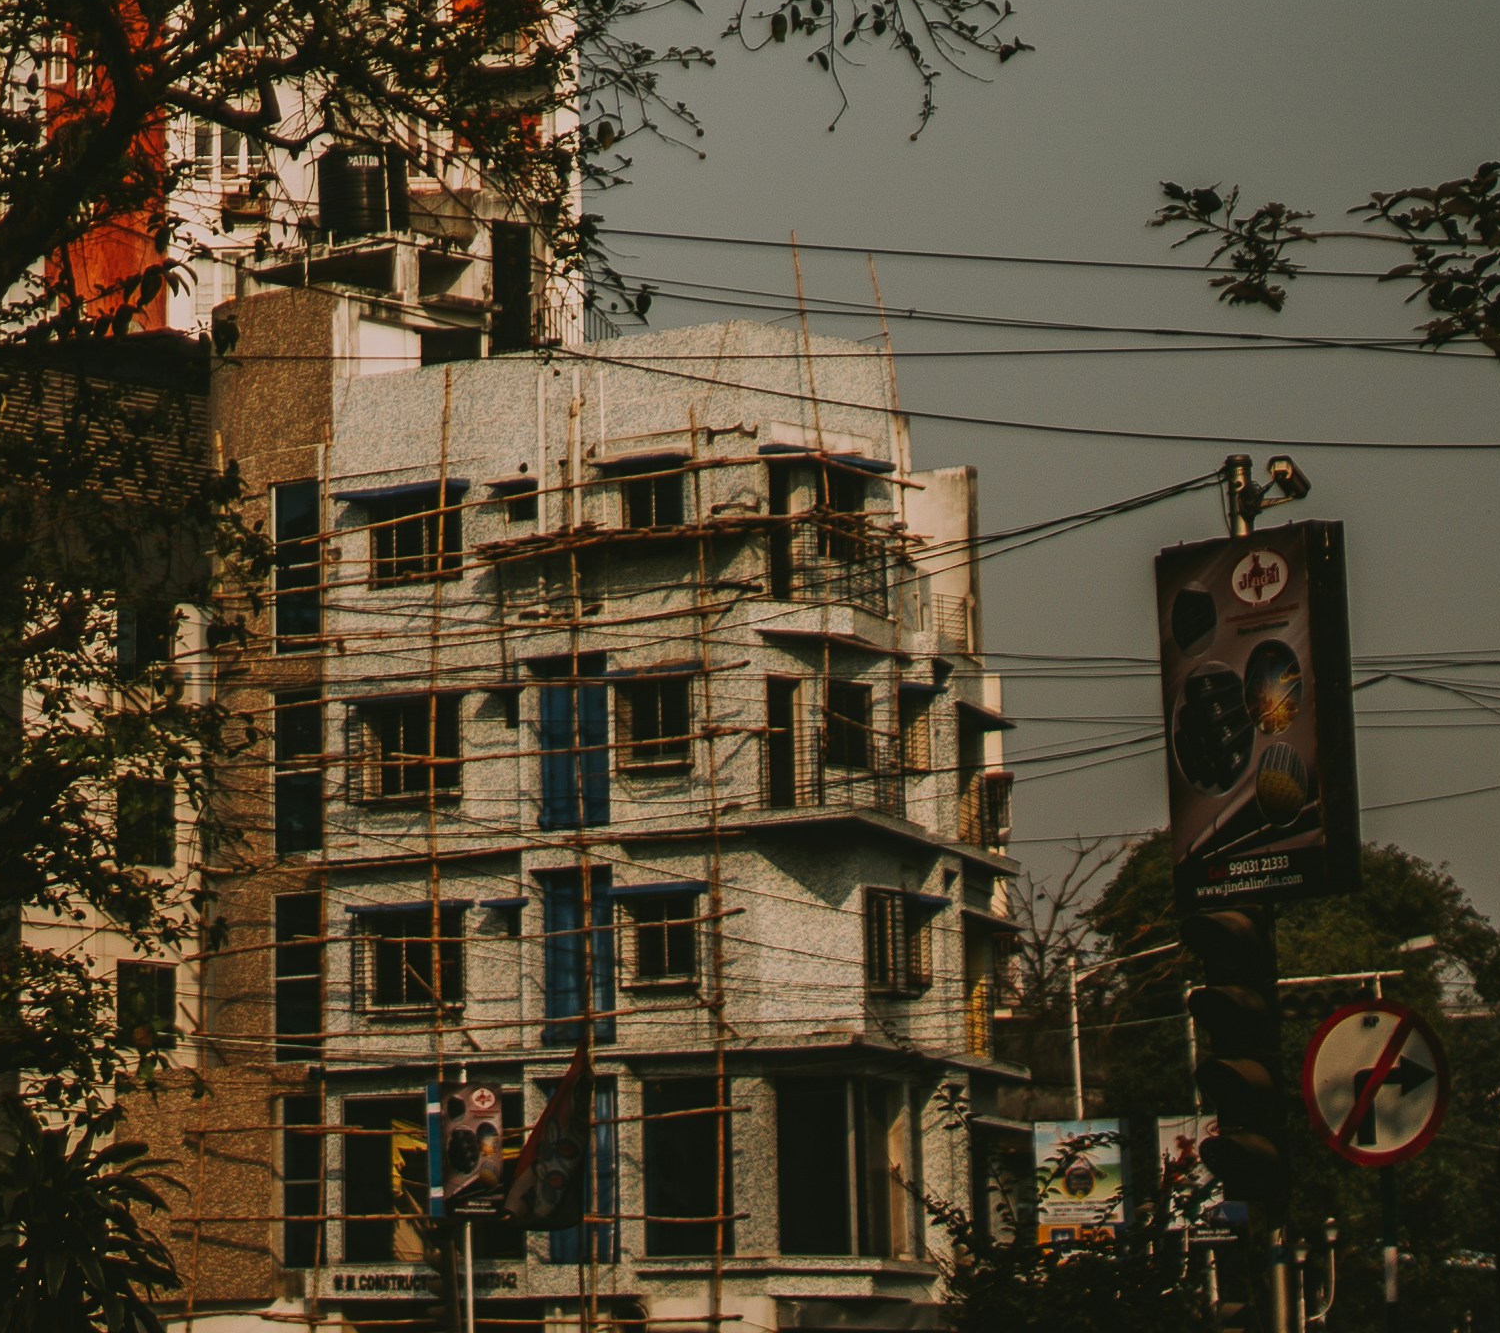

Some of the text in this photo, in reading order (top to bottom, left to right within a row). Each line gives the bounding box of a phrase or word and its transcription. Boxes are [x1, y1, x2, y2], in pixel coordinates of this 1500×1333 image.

[1229, 860, 1259, 875] 99031
[1262, 856, 1289, 870] 21333
[1197, 874, 1303, 895] www.jindalindia.com
